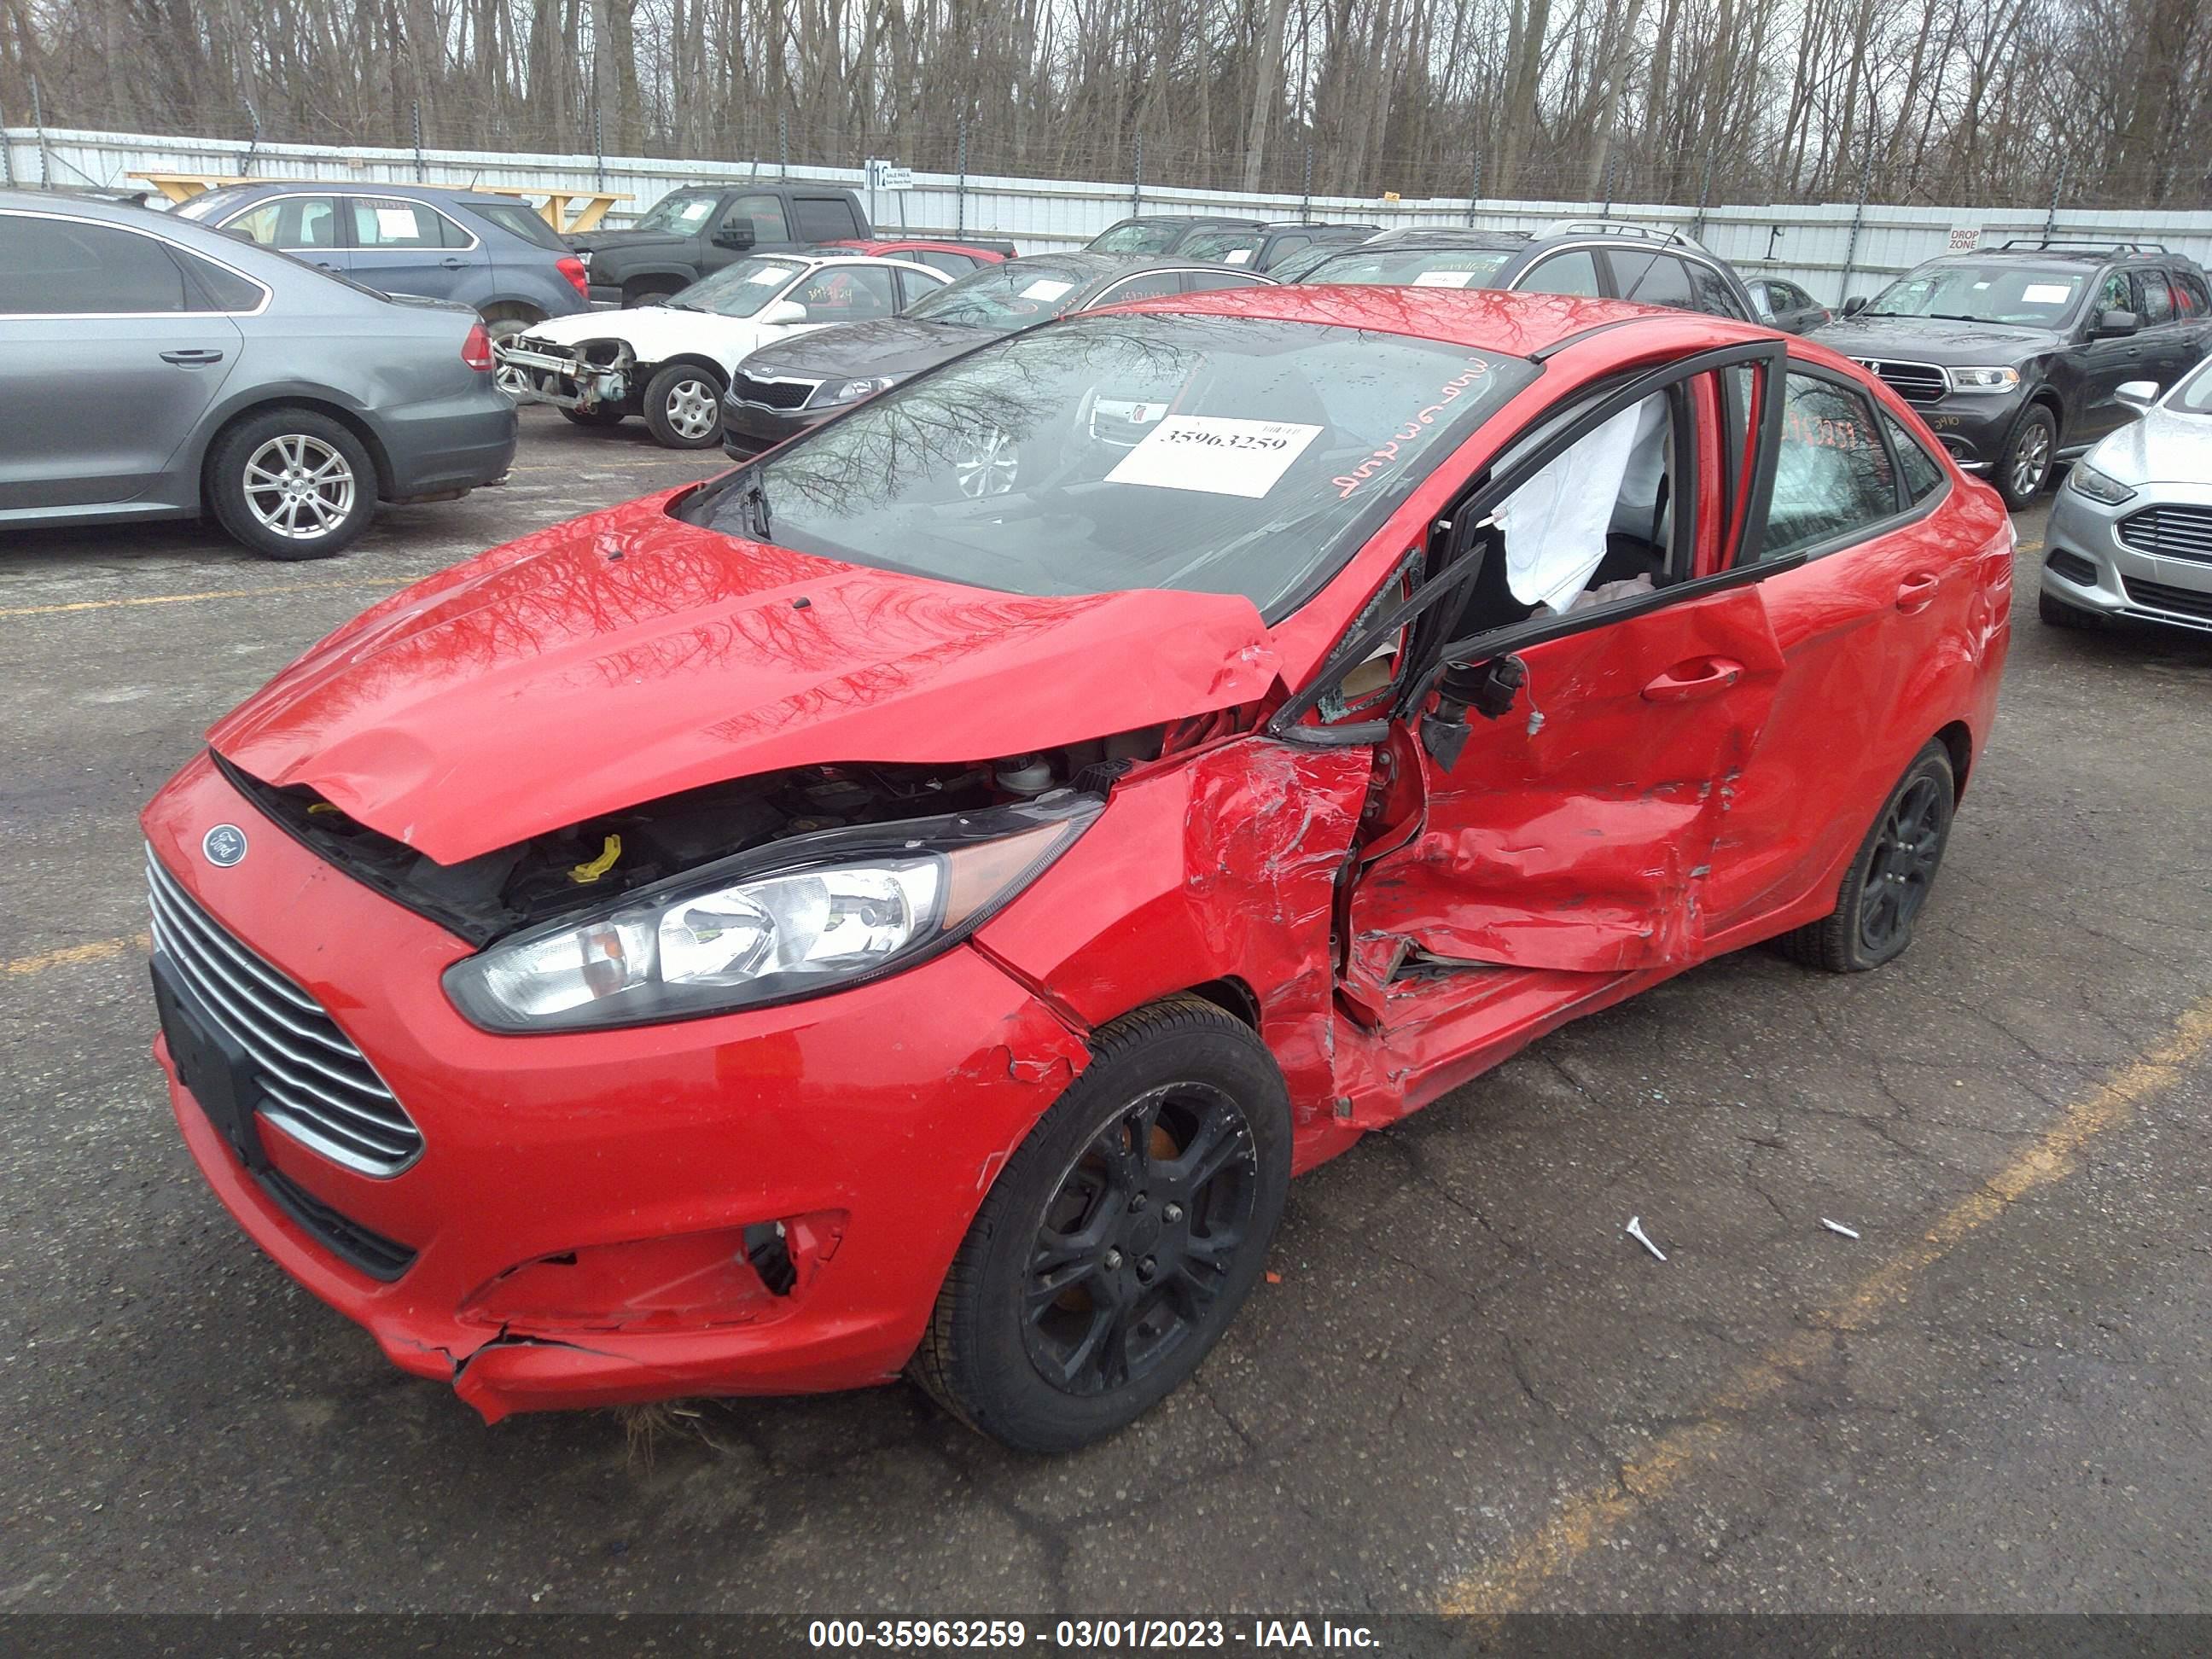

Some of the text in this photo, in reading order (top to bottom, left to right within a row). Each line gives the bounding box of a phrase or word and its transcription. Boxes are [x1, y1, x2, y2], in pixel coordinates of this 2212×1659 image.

[1949, 240, 1976, 249] ZONE
[1951, 230, 1979, 239] DROP
[1332, 358, 1488, 498] 35963259
[1160, 430, 1288, 451] 35963259
[210, 831, 238, 859] Ford
